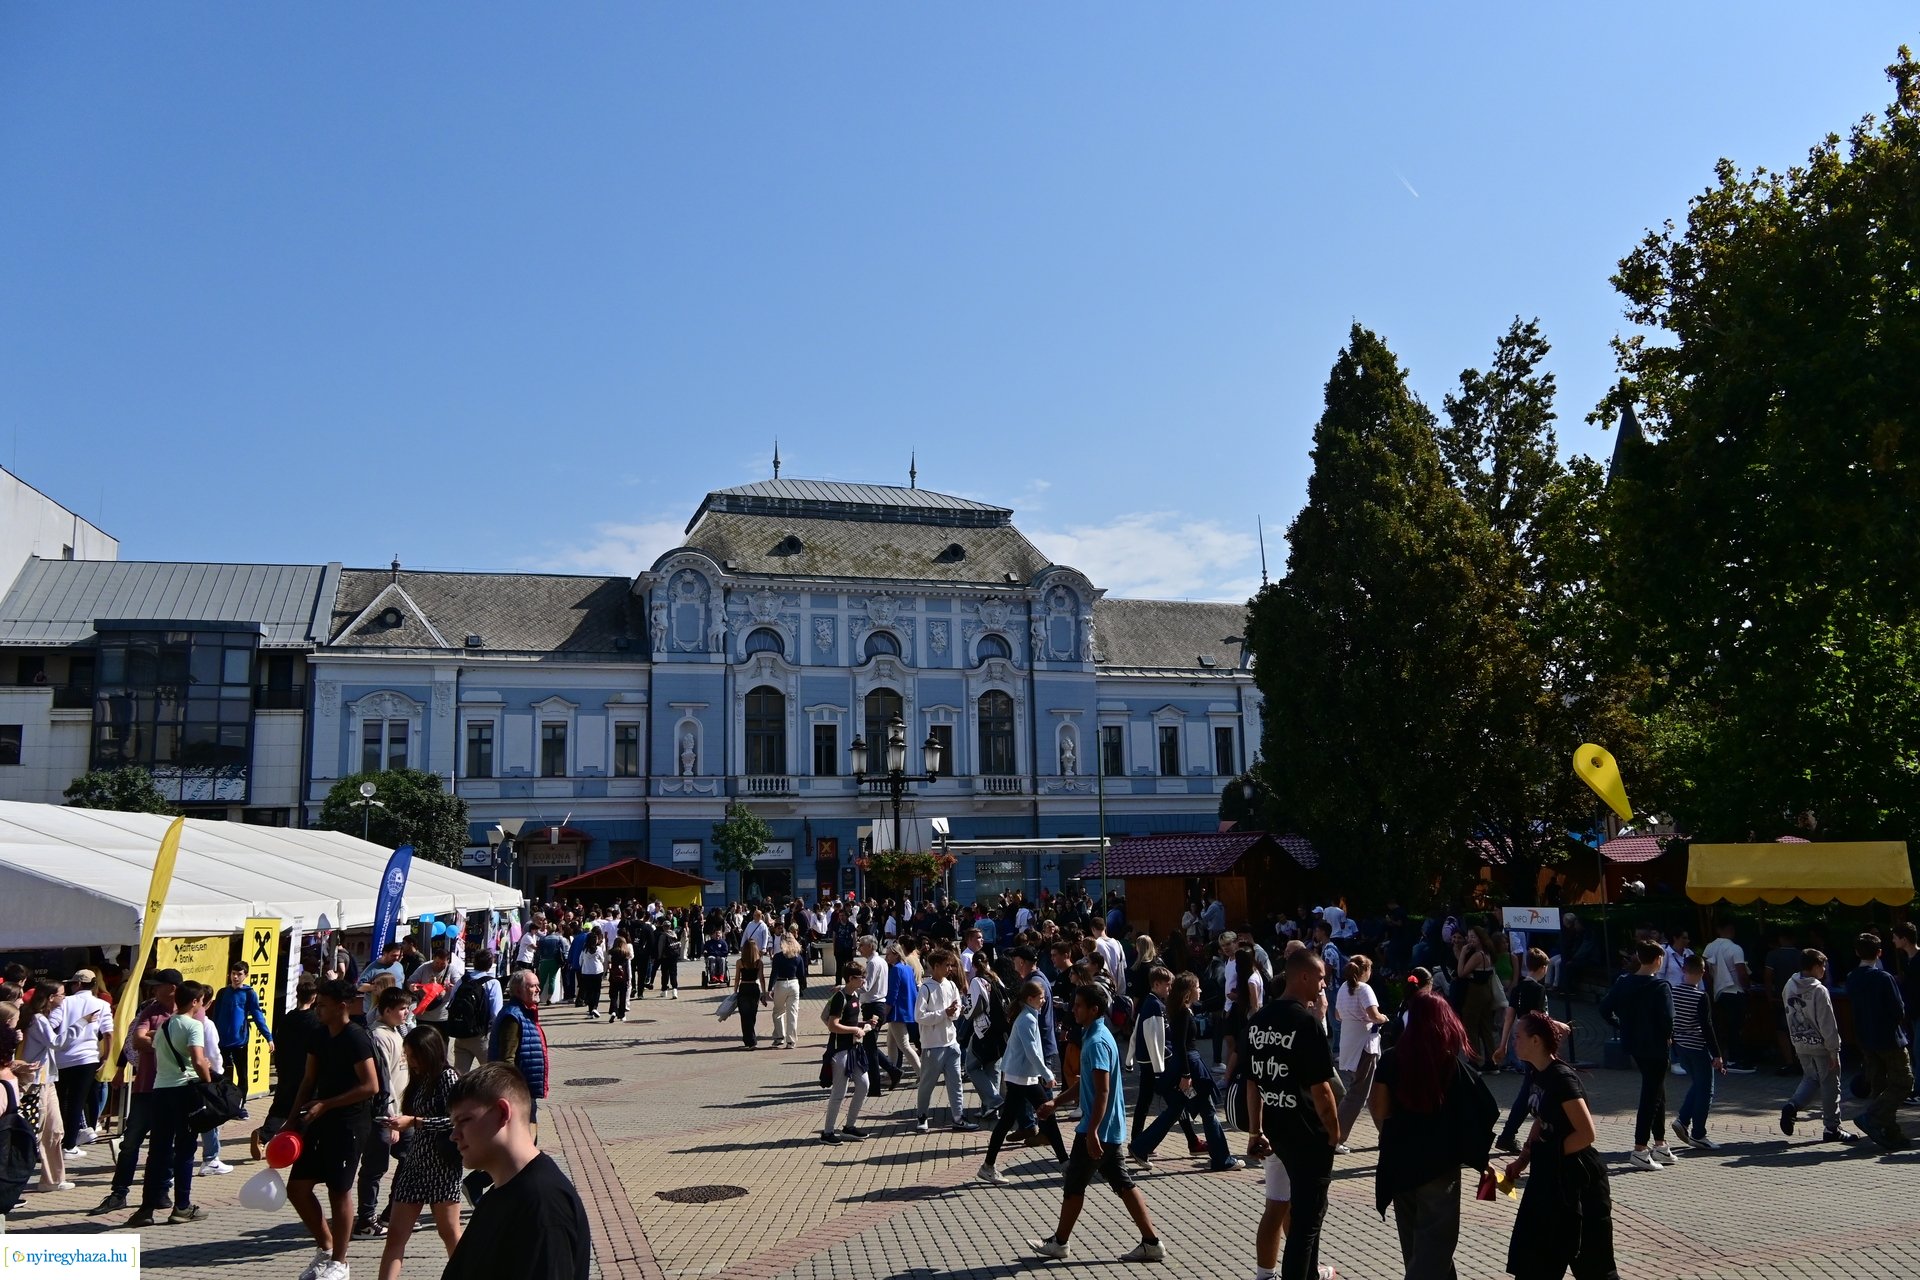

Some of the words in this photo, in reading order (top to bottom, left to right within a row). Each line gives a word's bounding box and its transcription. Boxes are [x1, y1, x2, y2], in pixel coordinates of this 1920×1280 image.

[1513, 915, 1528, 923] INFO
[1248, 1025, 1297, 1050] Raised
[1251, 1055, 1264, 1079] by
[1266, 1055, 1289, 1081] the
